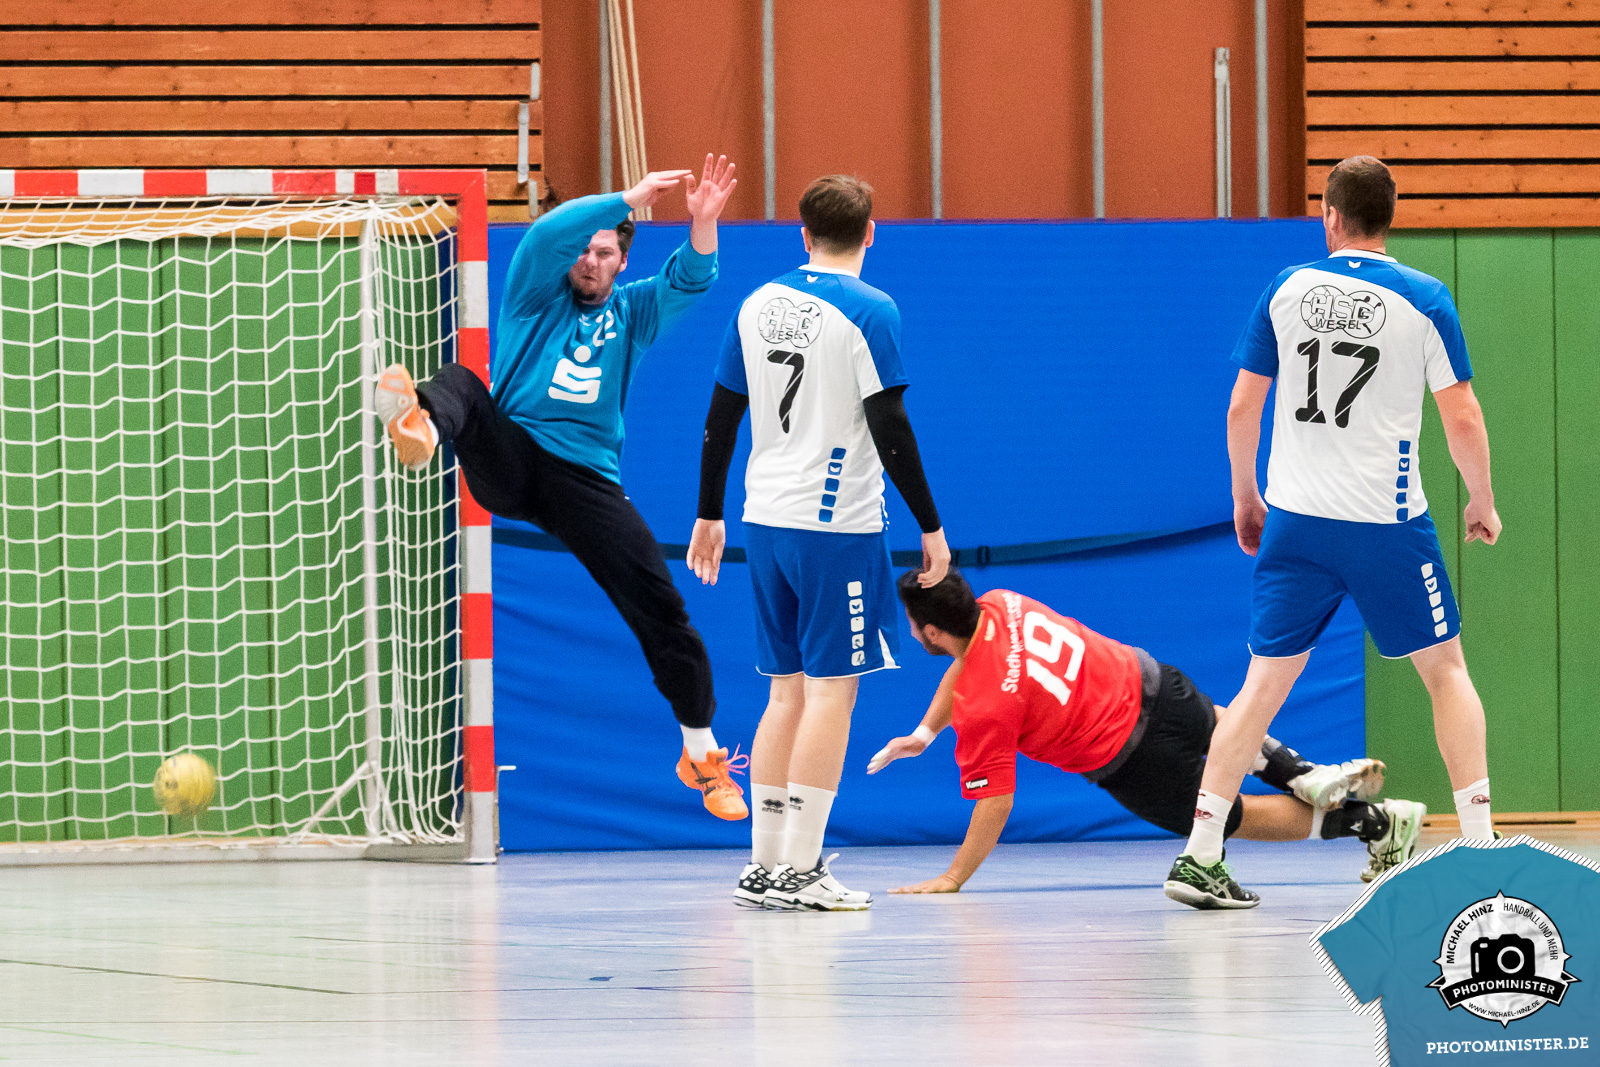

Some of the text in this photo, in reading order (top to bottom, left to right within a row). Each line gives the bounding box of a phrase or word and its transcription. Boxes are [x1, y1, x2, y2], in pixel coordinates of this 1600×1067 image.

[1311, 294, 1375, 324] HSG
[1315, 317, 1361, 330] WESEL
[767, 349, 804, 434] 7
[1295, 337, 1380, 428] 17
[1022, 611, 1085, 706] 19
